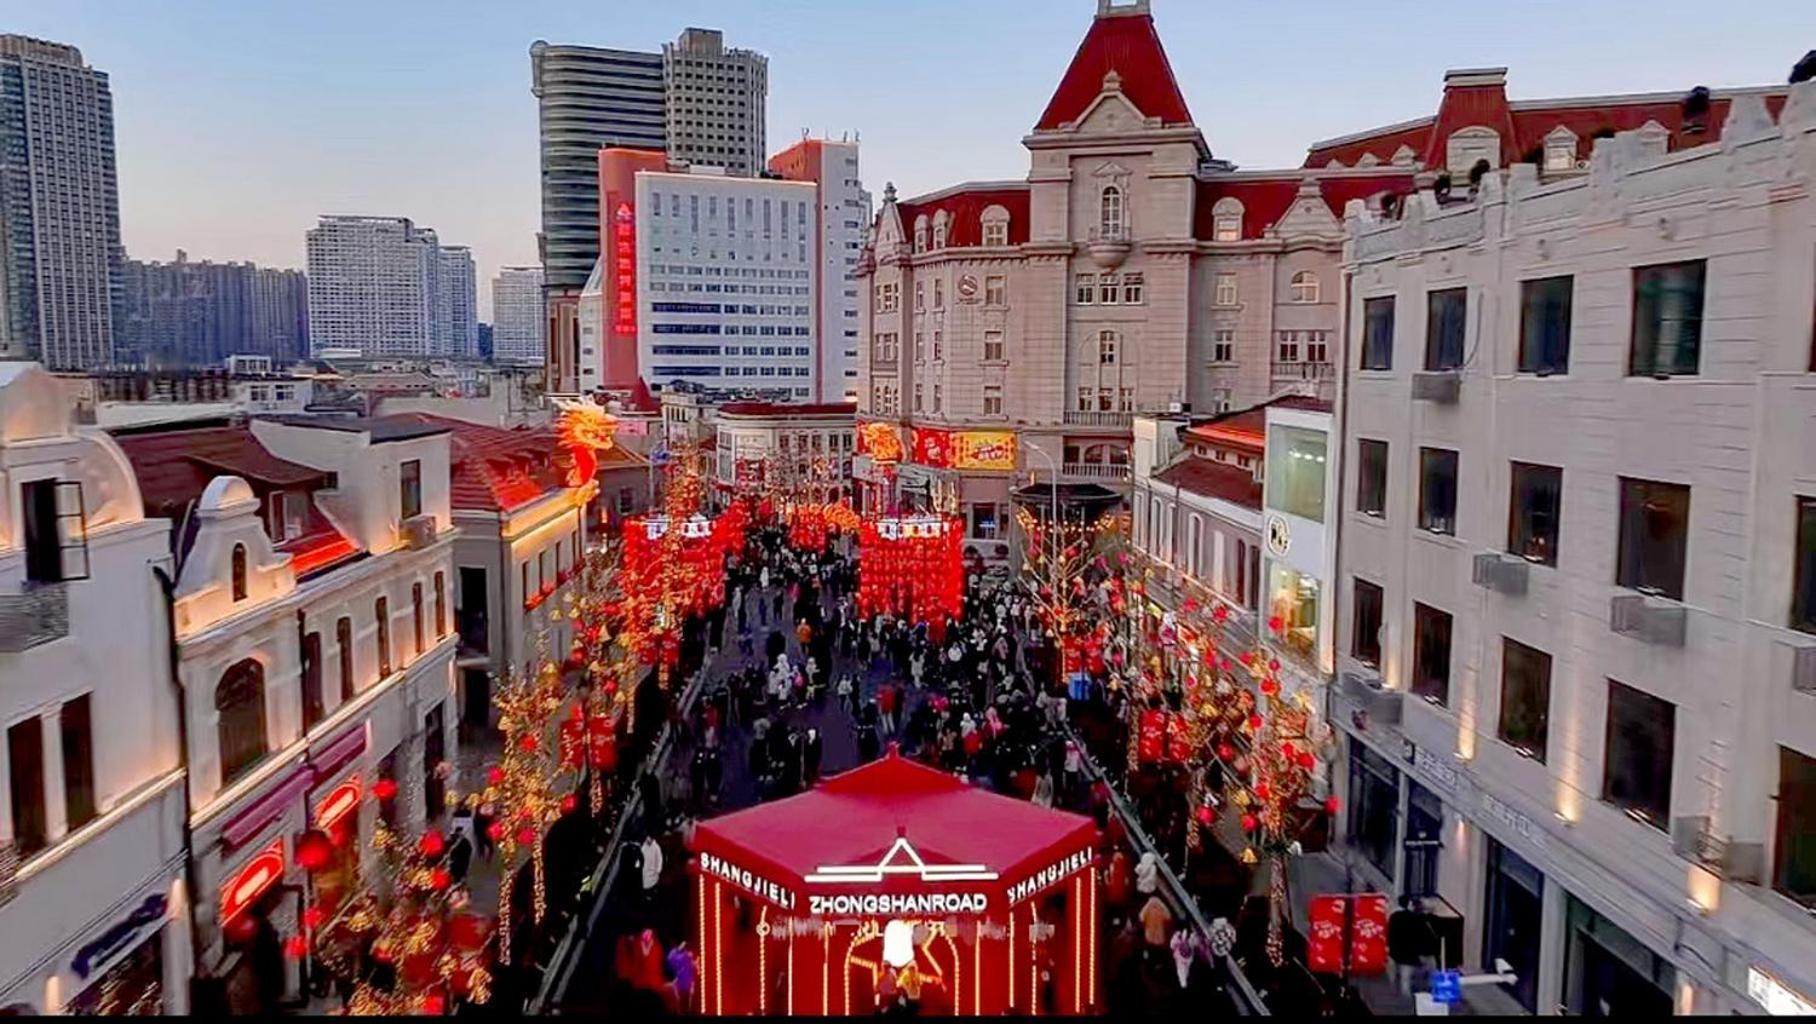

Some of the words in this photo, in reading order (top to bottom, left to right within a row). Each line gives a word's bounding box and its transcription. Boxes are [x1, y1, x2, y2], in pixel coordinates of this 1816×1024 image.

[701, 852, 795, 909] SHANGJIELI
[809, 893, 987, 914] ZHONGSHANROAD
[1007, 846, 1092, 904] SHANGJIELI
